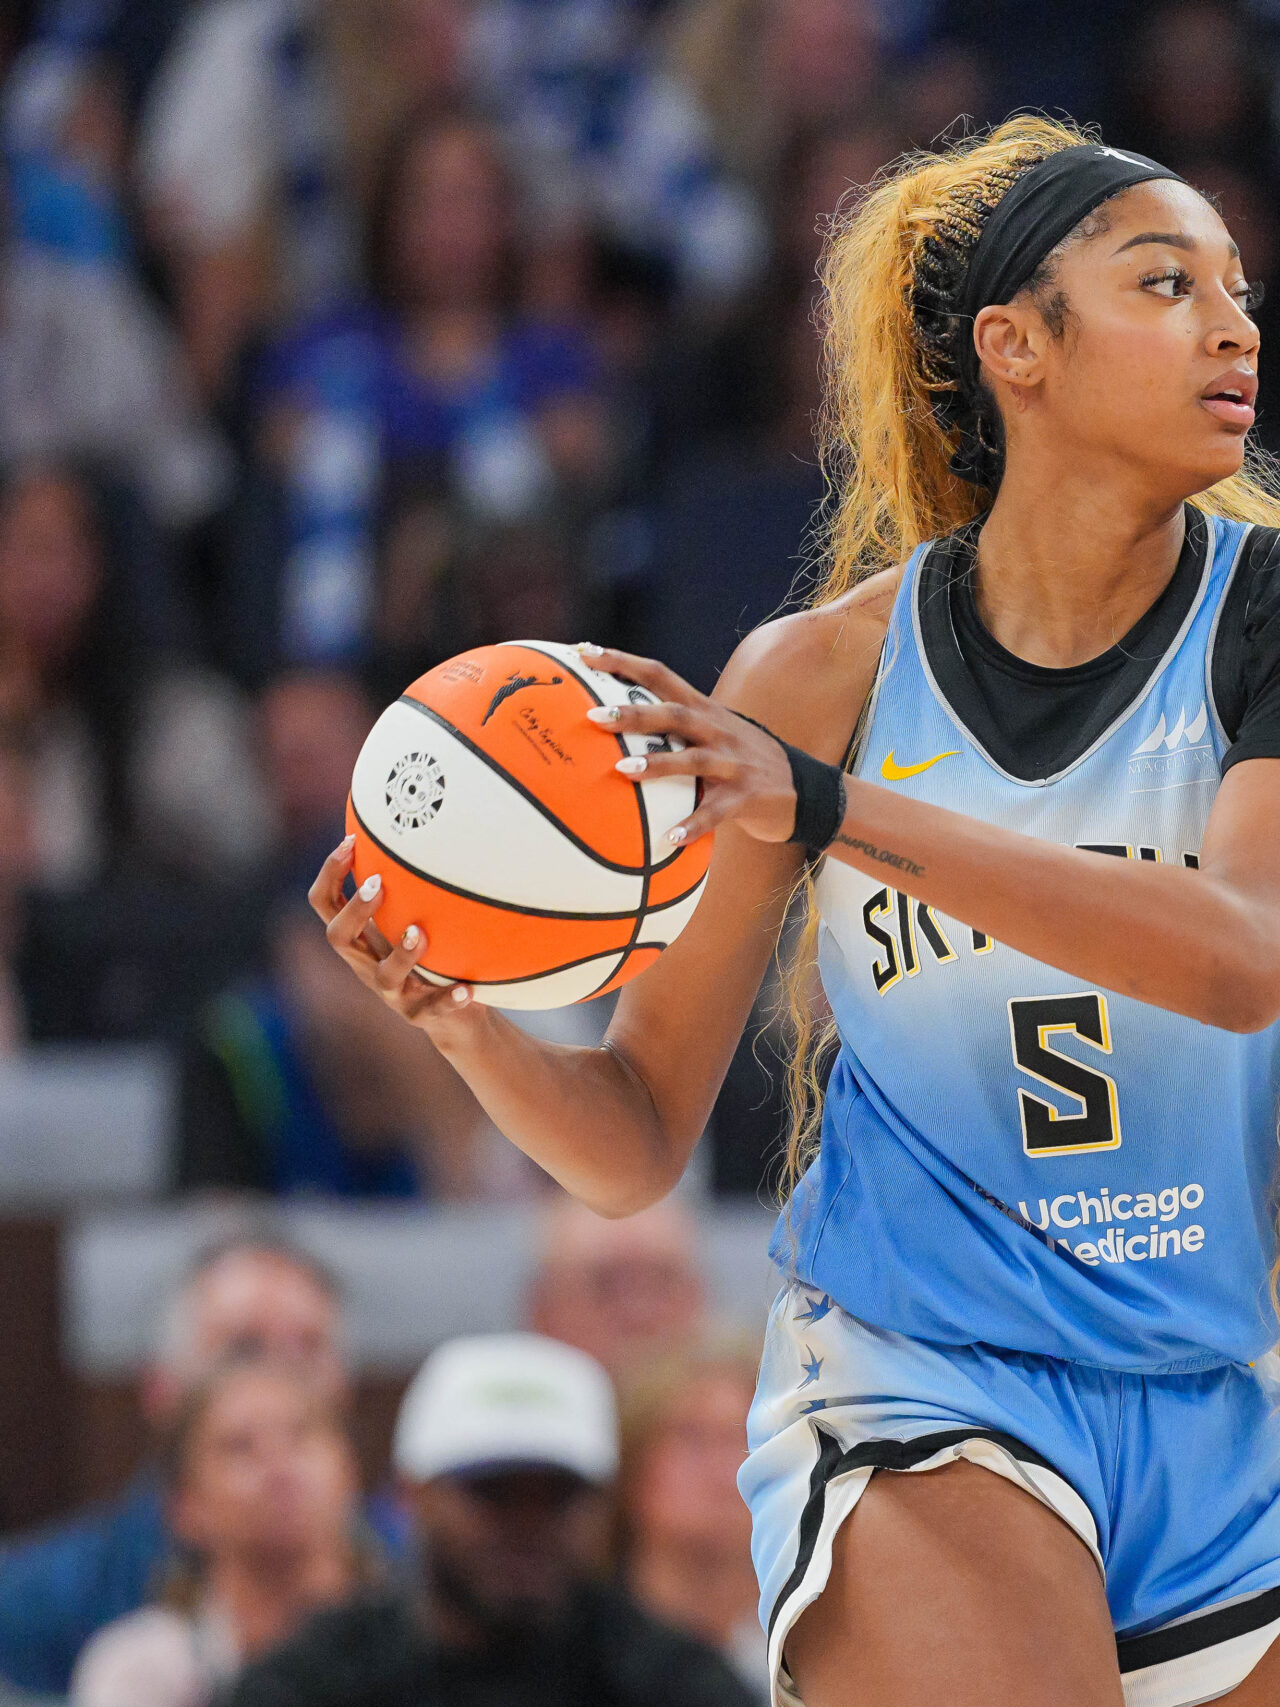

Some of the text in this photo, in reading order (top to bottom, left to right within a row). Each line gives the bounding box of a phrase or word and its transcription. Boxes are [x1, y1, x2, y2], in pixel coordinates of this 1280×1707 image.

[1007, 990, 1122, 1158] 5
[1018, 1183, 1205, 1231] UChicago
[1046, 1224, 1205, 1267] edicine
